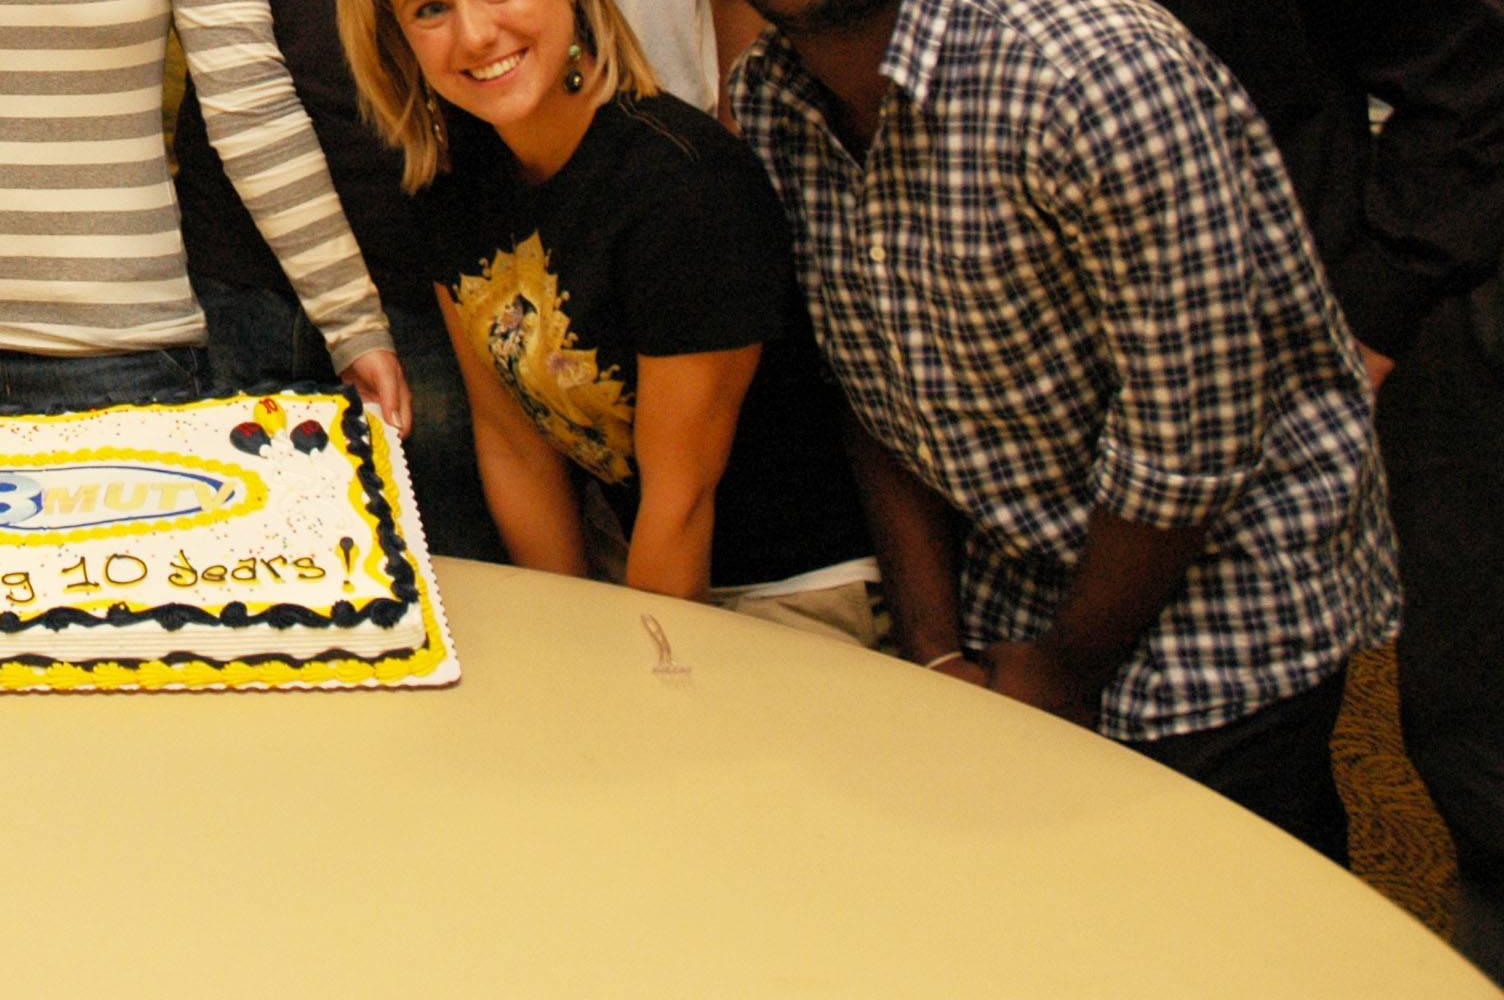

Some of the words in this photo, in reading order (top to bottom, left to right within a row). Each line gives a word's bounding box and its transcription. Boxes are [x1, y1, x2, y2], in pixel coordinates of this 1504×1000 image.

[259, 398, 278, 414] 10
[42, 481, 238, 515] MUTV
[61, 552, 148, 588] 10
